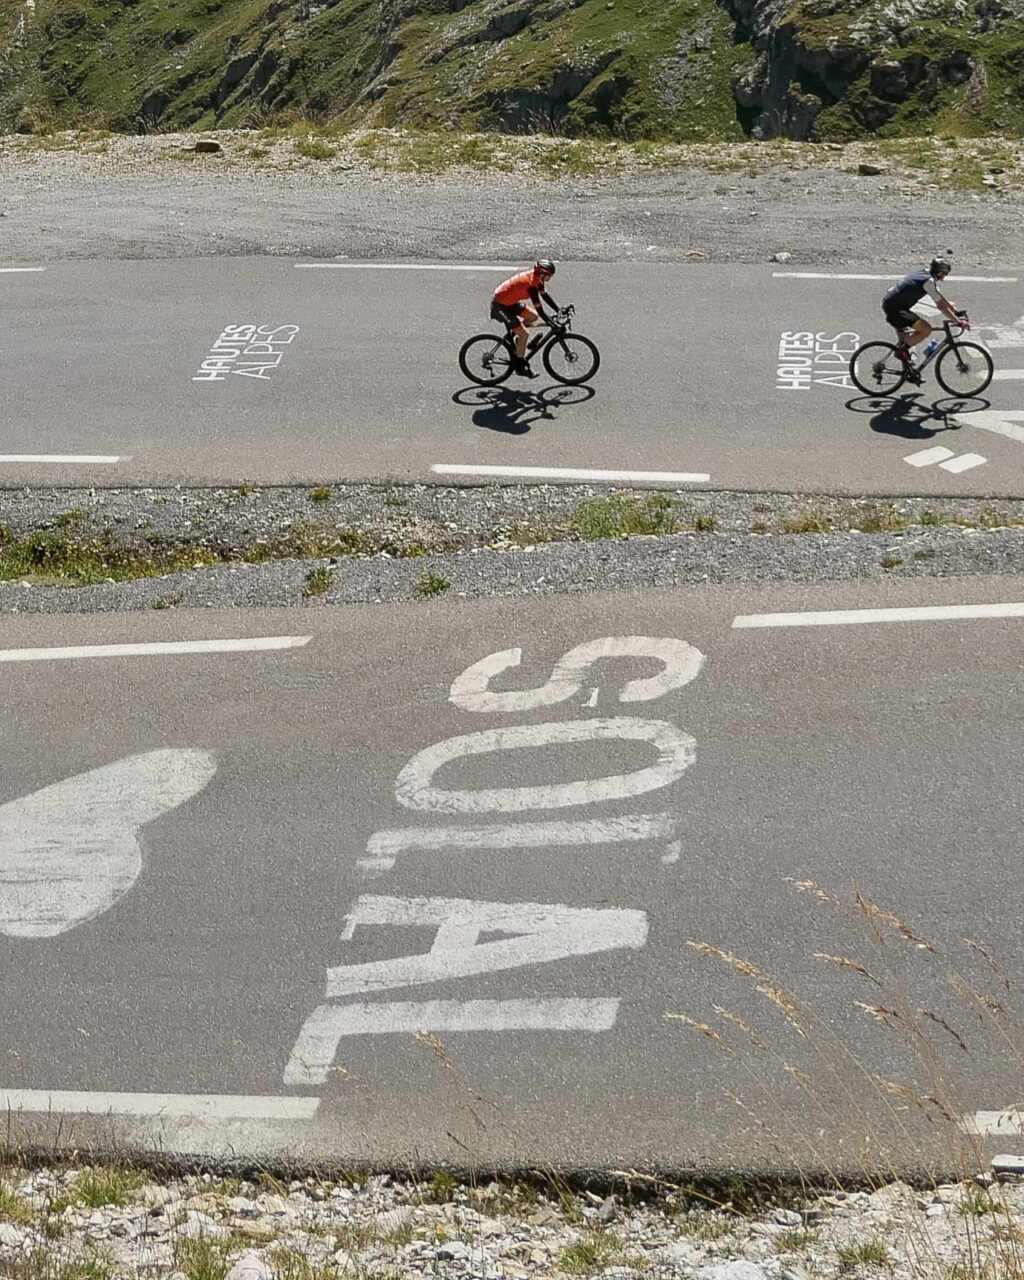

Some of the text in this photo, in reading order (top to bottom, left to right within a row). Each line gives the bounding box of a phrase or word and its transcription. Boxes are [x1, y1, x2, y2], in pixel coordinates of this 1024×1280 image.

[192, 325, 257, 380] HAUTES
[231, 324, 299, 379] ALPES
[776, 331, 814, 390] HAUTES
[812, 331, 860, 390] ALPES
